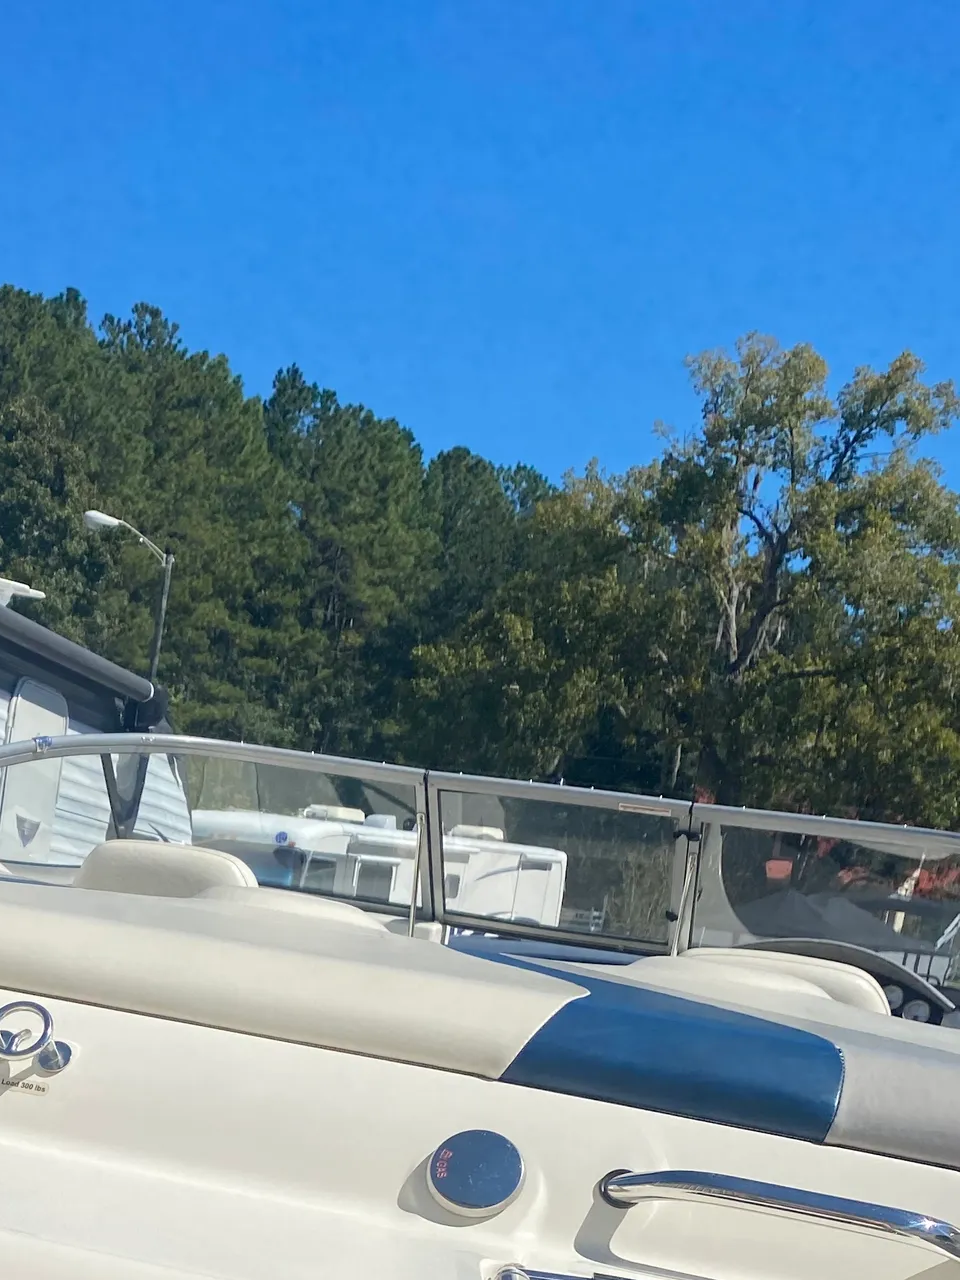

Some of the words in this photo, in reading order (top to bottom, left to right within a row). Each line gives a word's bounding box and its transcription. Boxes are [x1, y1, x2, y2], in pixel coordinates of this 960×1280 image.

[1, 1079, 20, 1088] Load
[20, 1082, 34, 1090] 300
[436, 1160, 447, 1178] GAS
